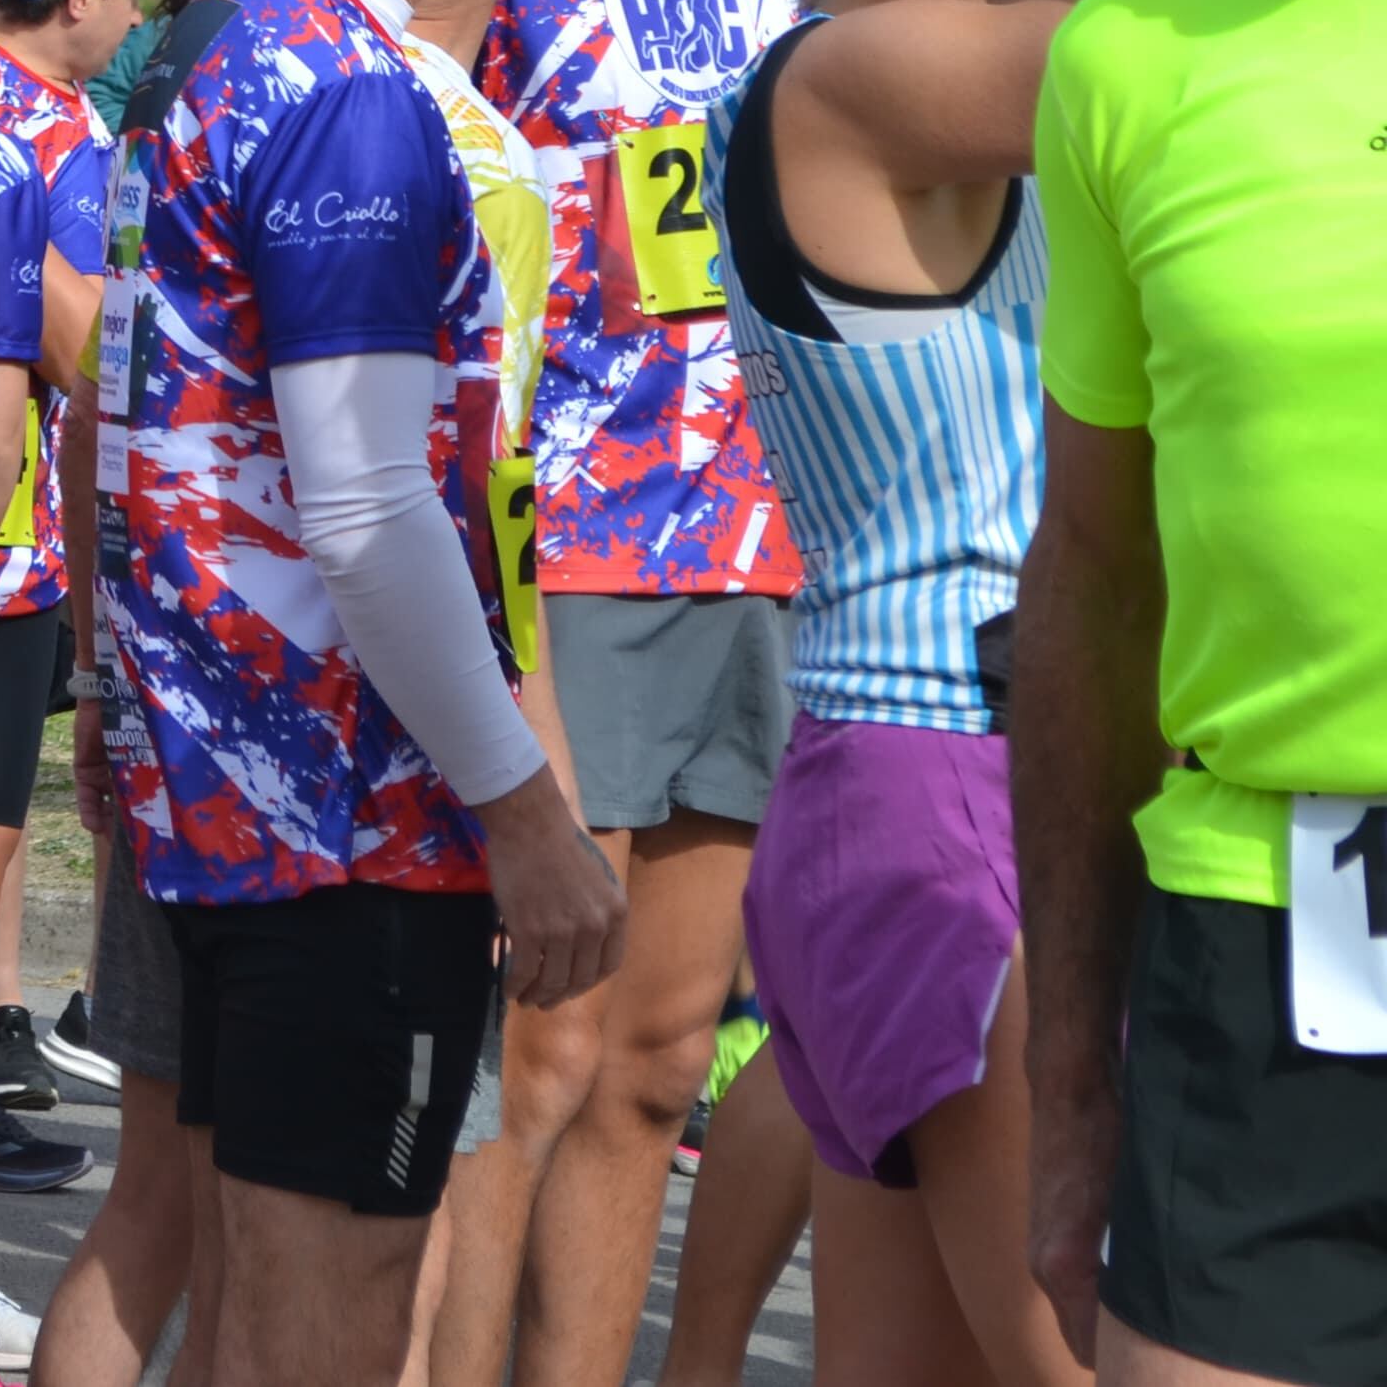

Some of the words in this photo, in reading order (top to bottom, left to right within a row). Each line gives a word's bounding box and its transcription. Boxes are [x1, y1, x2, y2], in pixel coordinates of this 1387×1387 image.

[265, 199, 304, 233] El
[315, 191, 400, 228] Criollo
[648, 147, 708, 236] 2
